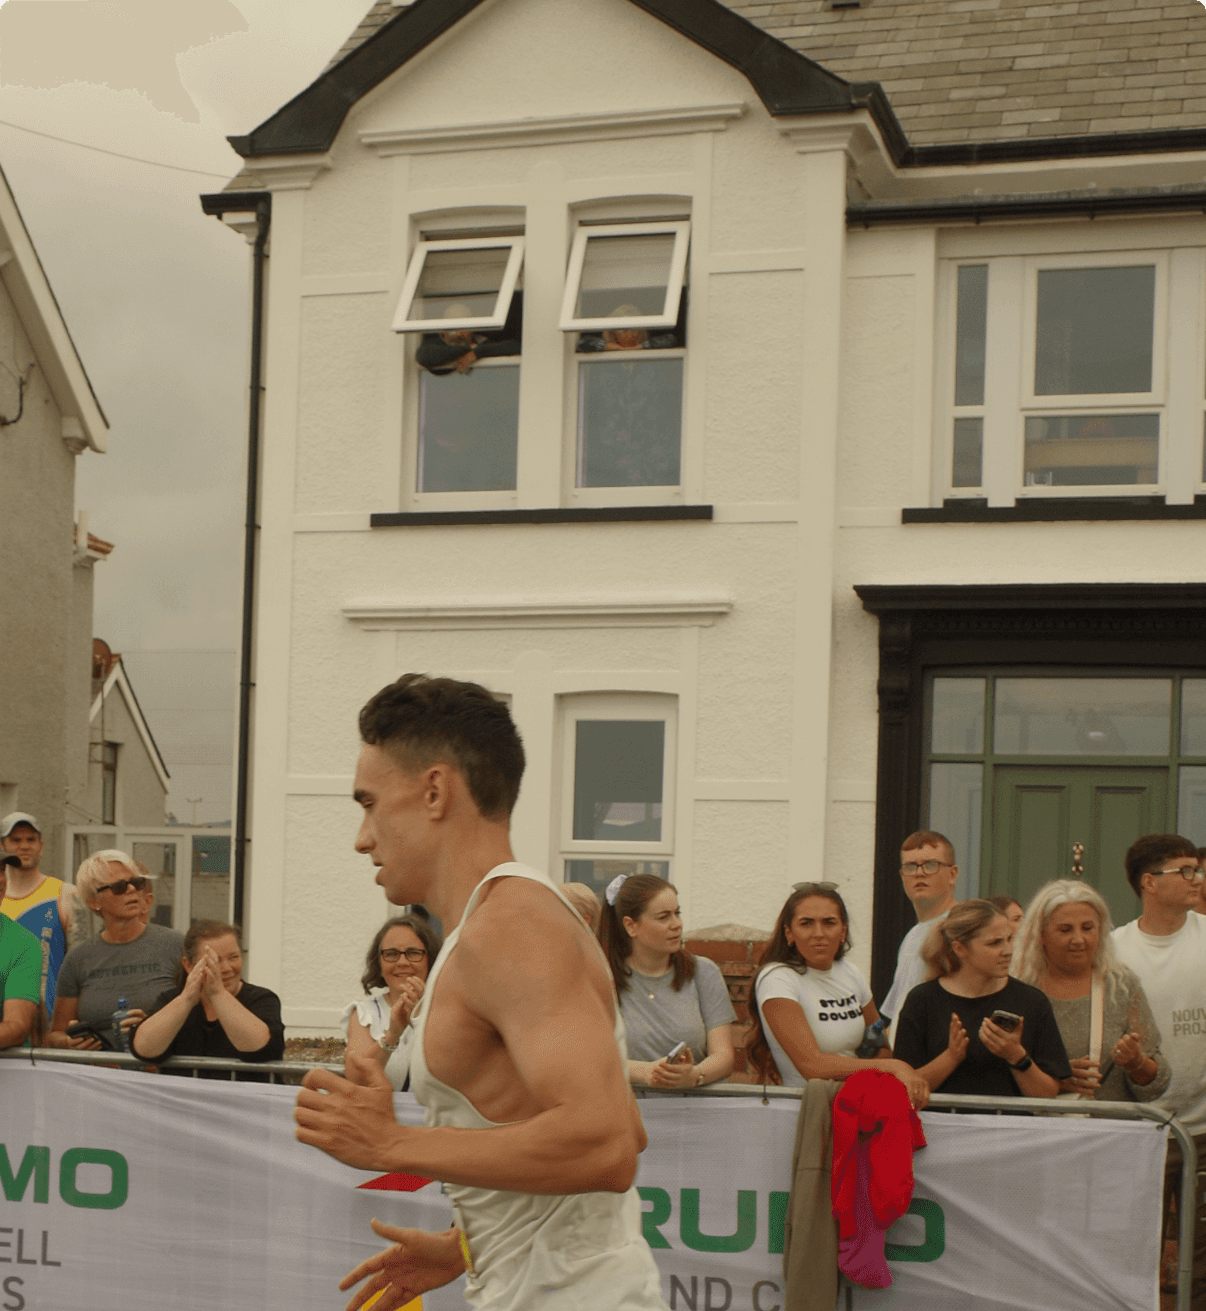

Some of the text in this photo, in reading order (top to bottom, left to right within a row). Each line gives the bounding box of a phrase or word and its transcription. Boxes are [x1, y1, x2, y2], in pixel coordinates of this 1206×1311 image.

[818, 1004, 864, 1021] DOUBL
[0, 1143, 129, 1210] MO
[2, 1276, 26, 1311] S
